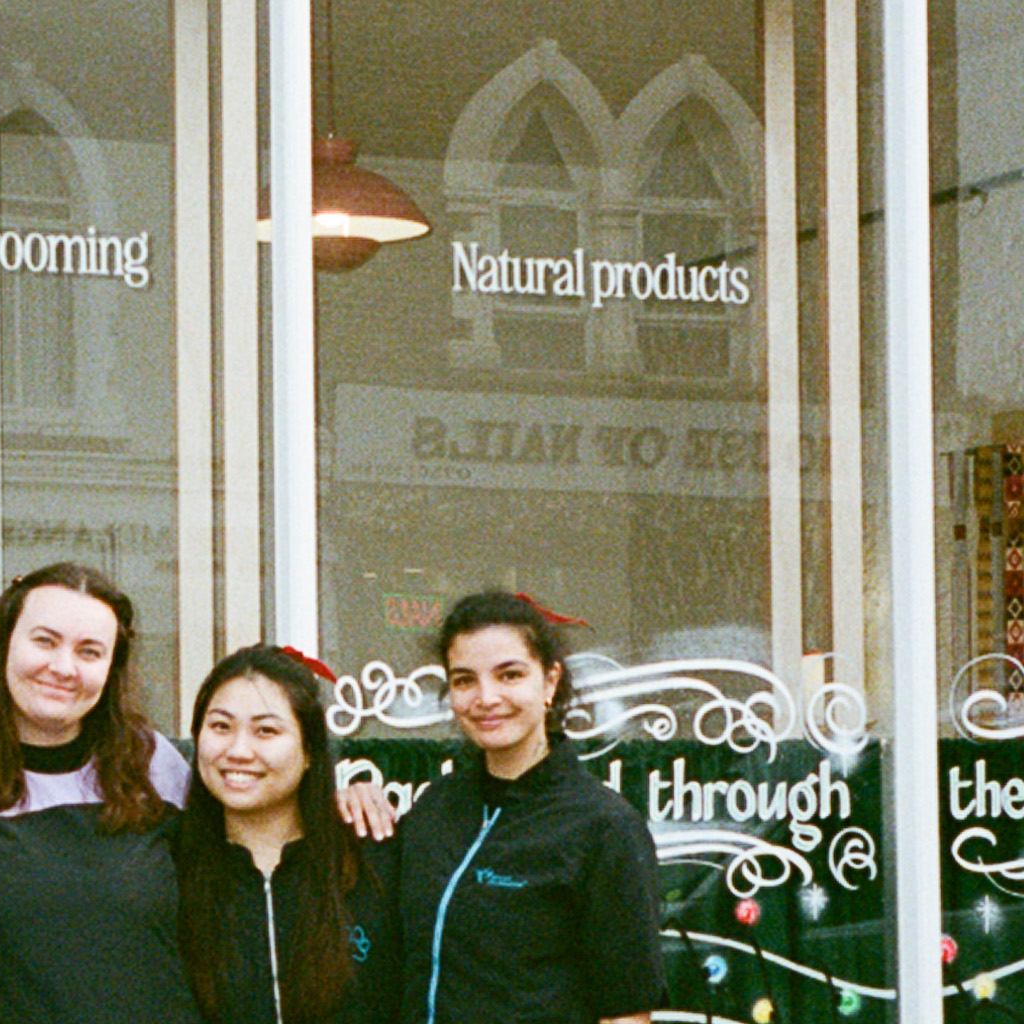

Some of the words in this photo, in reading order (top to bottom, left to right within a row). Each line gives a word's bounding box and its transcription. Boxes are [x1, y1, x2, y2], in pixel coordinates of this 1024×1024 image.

[451, 241, 585, 297] Natural
[591, 252, 750, 308] products
[648, 758, 852, 853] through
[949, 759, 1024, 820] the
